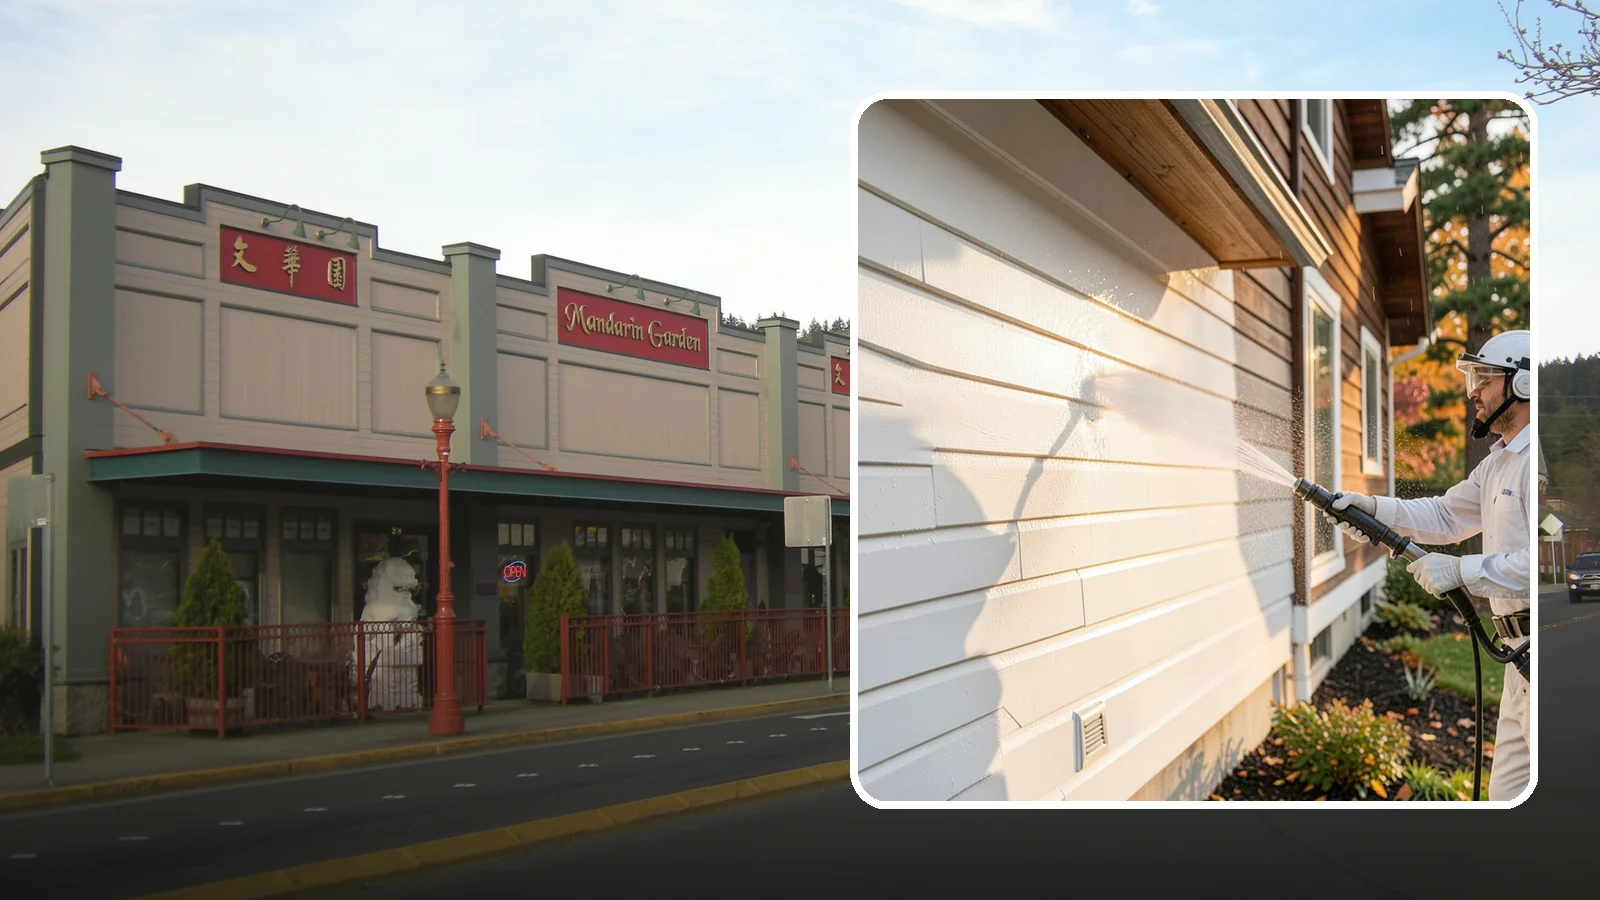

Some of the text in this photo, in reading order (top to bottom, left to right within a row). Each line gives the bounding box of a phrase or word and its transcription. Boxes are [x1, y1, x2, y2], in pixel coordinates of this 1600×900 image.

[231, 235, 346, 291] 文華園
[564, 302, 701, 352] Mandarin Garden
[503, 565, 527, 578] OPEN
